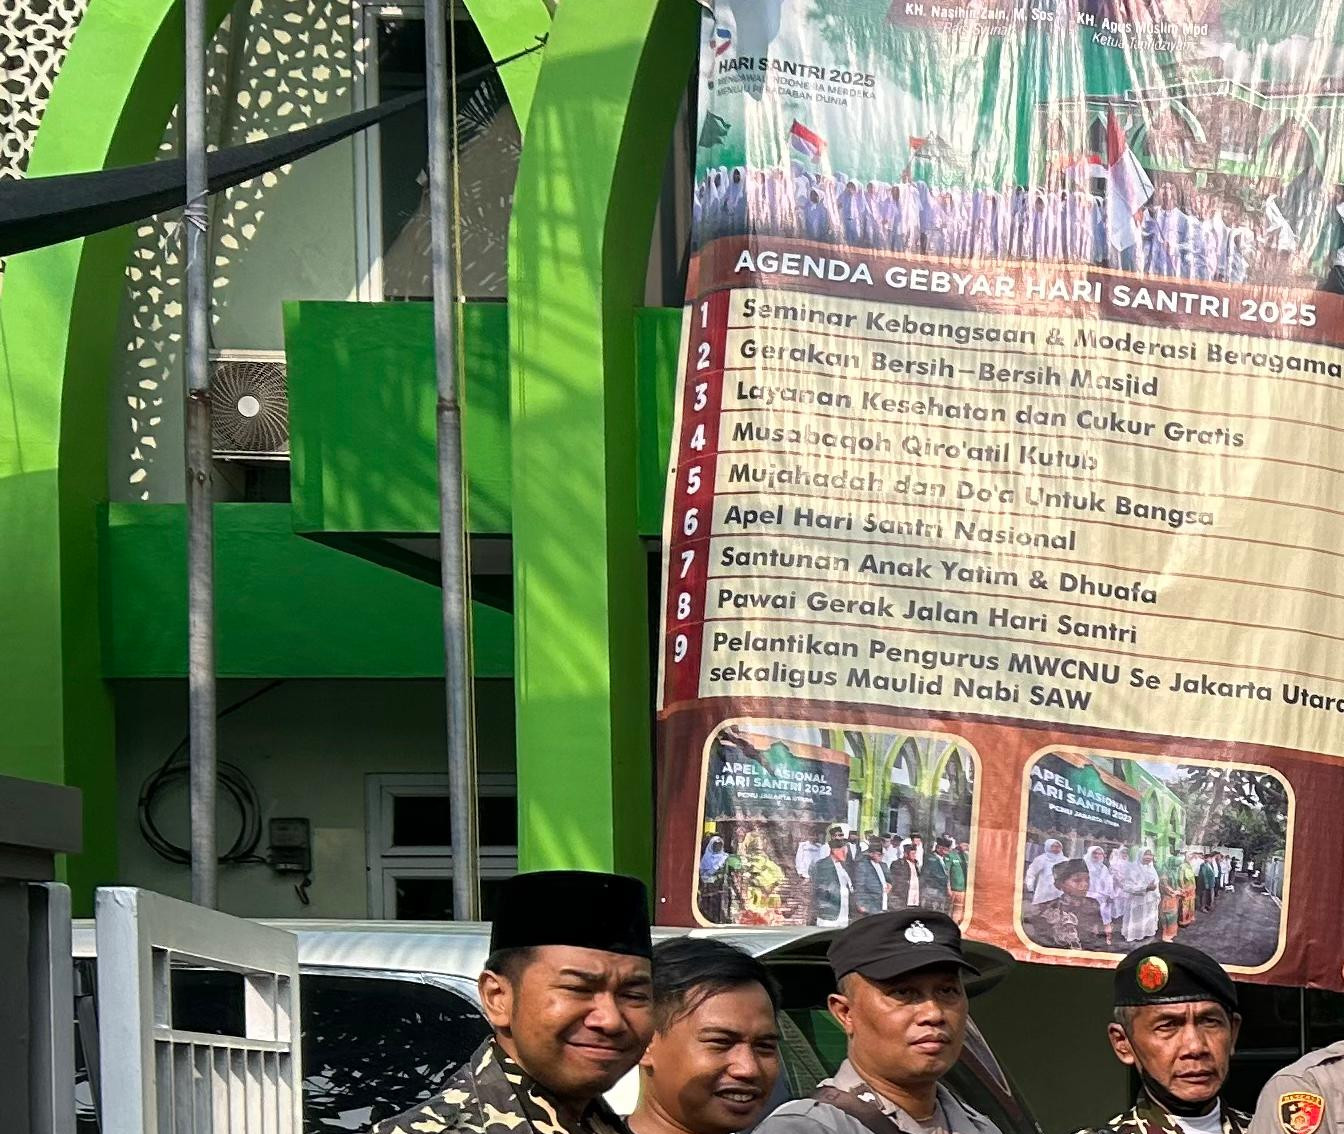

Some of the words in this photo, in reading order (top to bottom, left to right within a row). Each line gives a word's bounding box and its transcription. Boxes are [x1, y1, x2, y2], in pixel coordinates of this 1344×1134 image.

[1092, 32, 1126, 48] Ketua
[718, 57, 754, 74] HARI
[758, 57, 826, 80] SANTRI
[829, 69, 876, 88] 2025
[815, 94, 848, 106] DUNIA
[734, 250, 874, 285] AGENDA
[885, 266, 1015, 298] GEBYAR
[1025, 277, 1102, 304] HARI
[1112, 285, 1229, 318] SANTRI
[1239, 300, 1318, 327] 2025
[700, 301, 709, 328] 1
[742, 299, 857, 328] Seminar
[866, 311, 1036, 347] Kebangsaan
[1045, 327, 1066, 347] &
[1074, 328, 1197, 361] Moderasi
[1207, 343, 1344, 379] Beragama
[696, 343, 711, 371] 2
[740, 340, 861, 369] Gerakan
[1070, 369, 1159, 398] Masjid
[693, 382, 708, 411] 3
[736, 380, 852, 409] Layanan
[861, 391, 1007, 423] Kesehatan
[1015, 405, 1066, 428] dan
[1076, 410, 1156, 436] Cukur
[1164, 422, 1245, 448] Gratis
[690, 424, 706, 451] 4
[731, 422, 892, 455] Musabaqoh
[902, 435, 1010, 463] Qiro'atil
[1019, 445, 1098, 471] Kutub
[686, 466, 702, 495] 5
[728, 463, 884, 492] Mujahadah
[894, 474, 947, 498] dan
[956, 480, 1015, 504] Do'a
[1024, 486, 1106, 513] Untuk
[1116, 495, 1214, 528] Bangsa
[683, 507, 699, 536] 6
[723, 504, 784, 530] Apel
[793, 506, 853, 532] Hari
[862, 512, 943, 539] Santri
[954, 520, 1076, 551] Nasional
[679, 550, 695, 579] 7
[720, 546, 850, 572] Santunan
[858, 554, 933, 580] Anak
[939, 560, 1018, 587] Yatim
[1028, 570, 1049, 590] &
[1059, 572, 1158, 604] Dhuafa
[677, 592, 692, 620] 8
[717, 588, 797, 611] Pawai
[806, 591, 895, 618] Gerak
[902, 600, 979, 626] Jalan
[988, 607, 1048, 633] Hari
[1056, 614, 1138, 645] Santri
[673, 634, 688, 663] 9
[713, 631, 859, 659] Pelantikan
[869, 639, 1000, 672] Pengurus
[1007, 652, 1121, 685] MWCNU
[1129, 668, 1162, 690] Se
[1169, 672, 1273, 702] Jakarta
[709, 660, 838, 688] sekaligus
[846, 667, 944, 697] Maulid
[954, 677, 1020, 704] Nabi
[1029, 684, 1093, 712] SAW
[714, 774, 750, 788] HARI
[753, 777, 802, 792] SANTRI
[804, 783, 833, 796] 2022
[722, 761, 760, 775] APEL
[1031, 764, 1074, 791] APEL
[1077, 784, 1129, 814] NASIONAL
[1031, 780, 1063, 800] ARI
[1066, 792, 1111, 816] SANTRI
